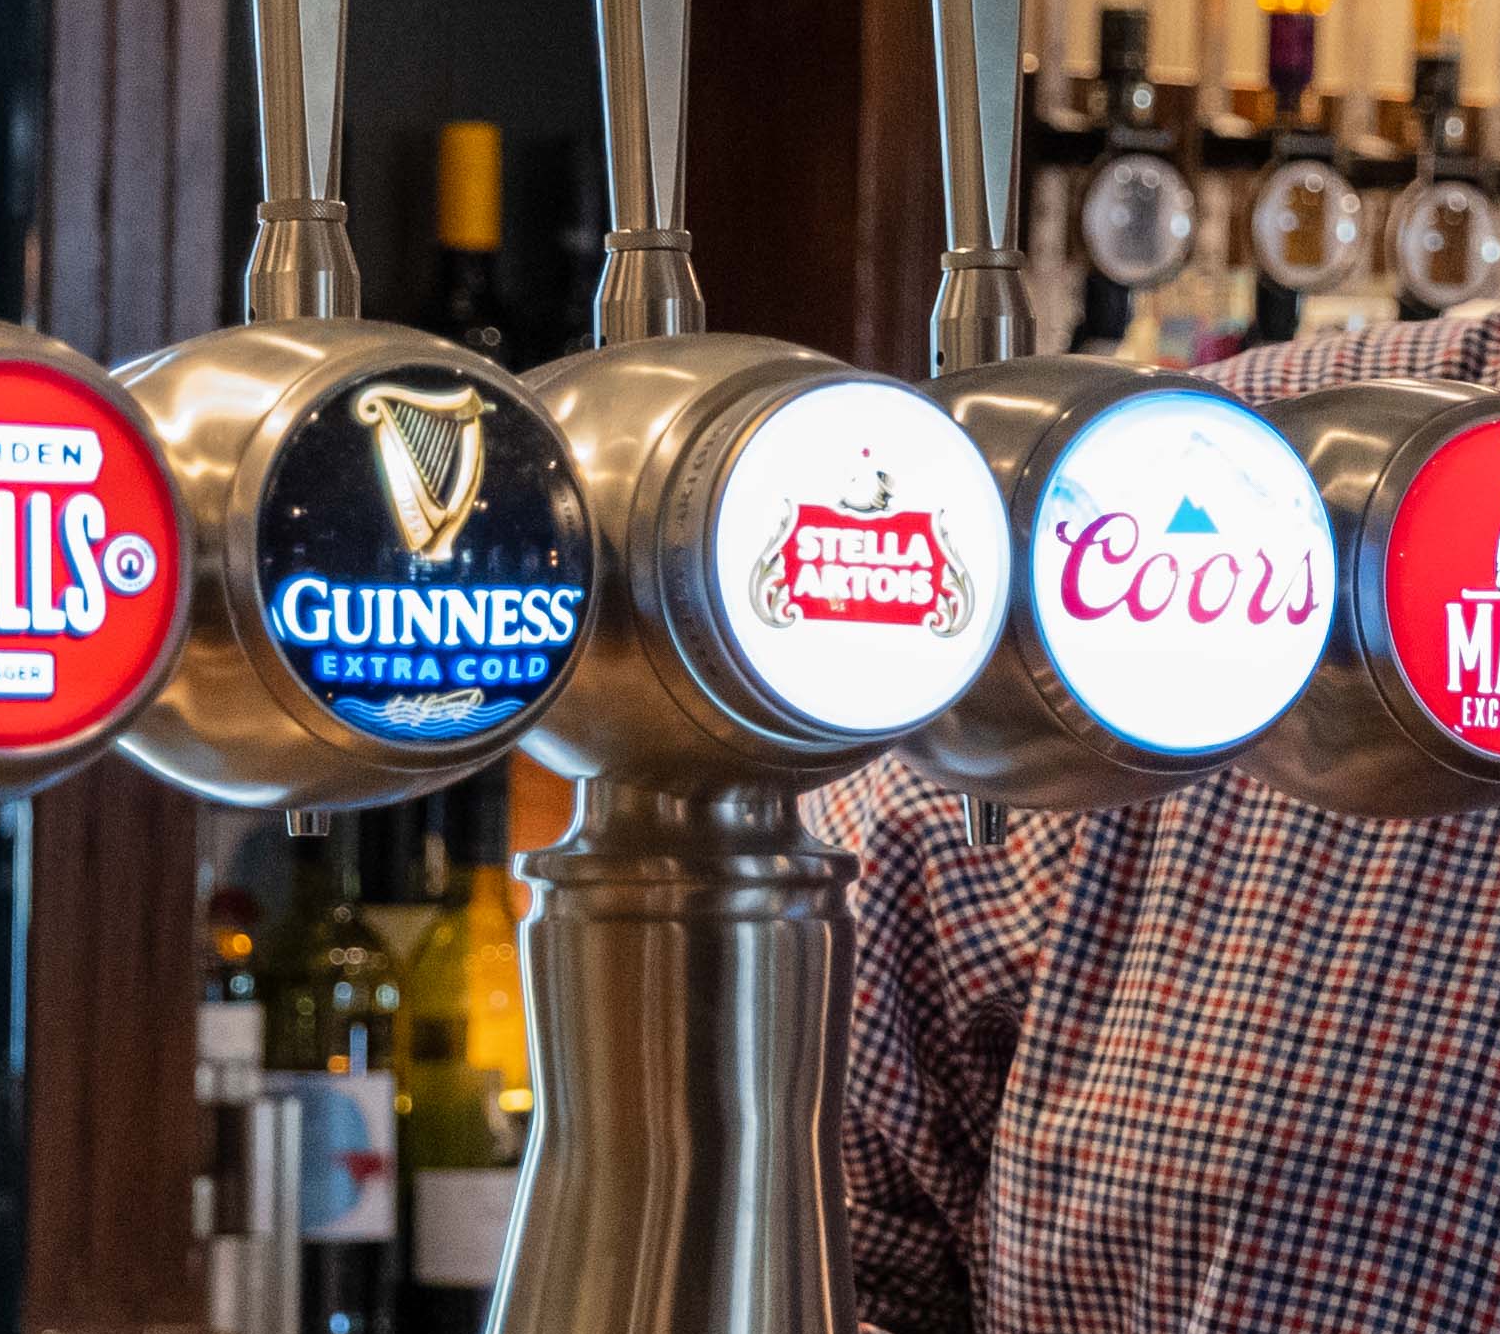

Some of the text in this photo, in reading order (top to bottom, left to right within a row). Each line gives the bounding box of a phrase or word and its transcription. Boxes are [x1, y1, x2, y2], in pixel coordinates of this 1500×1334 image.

[796, 526, 933, 567] STELLA
[793, 563, 934, 605] ARTOIS
[1055, 511, 1321, 625] Coors
[282, 577, 578, 646] GUINNESS
[323, 653, 549, 681] EXTRA COLD
